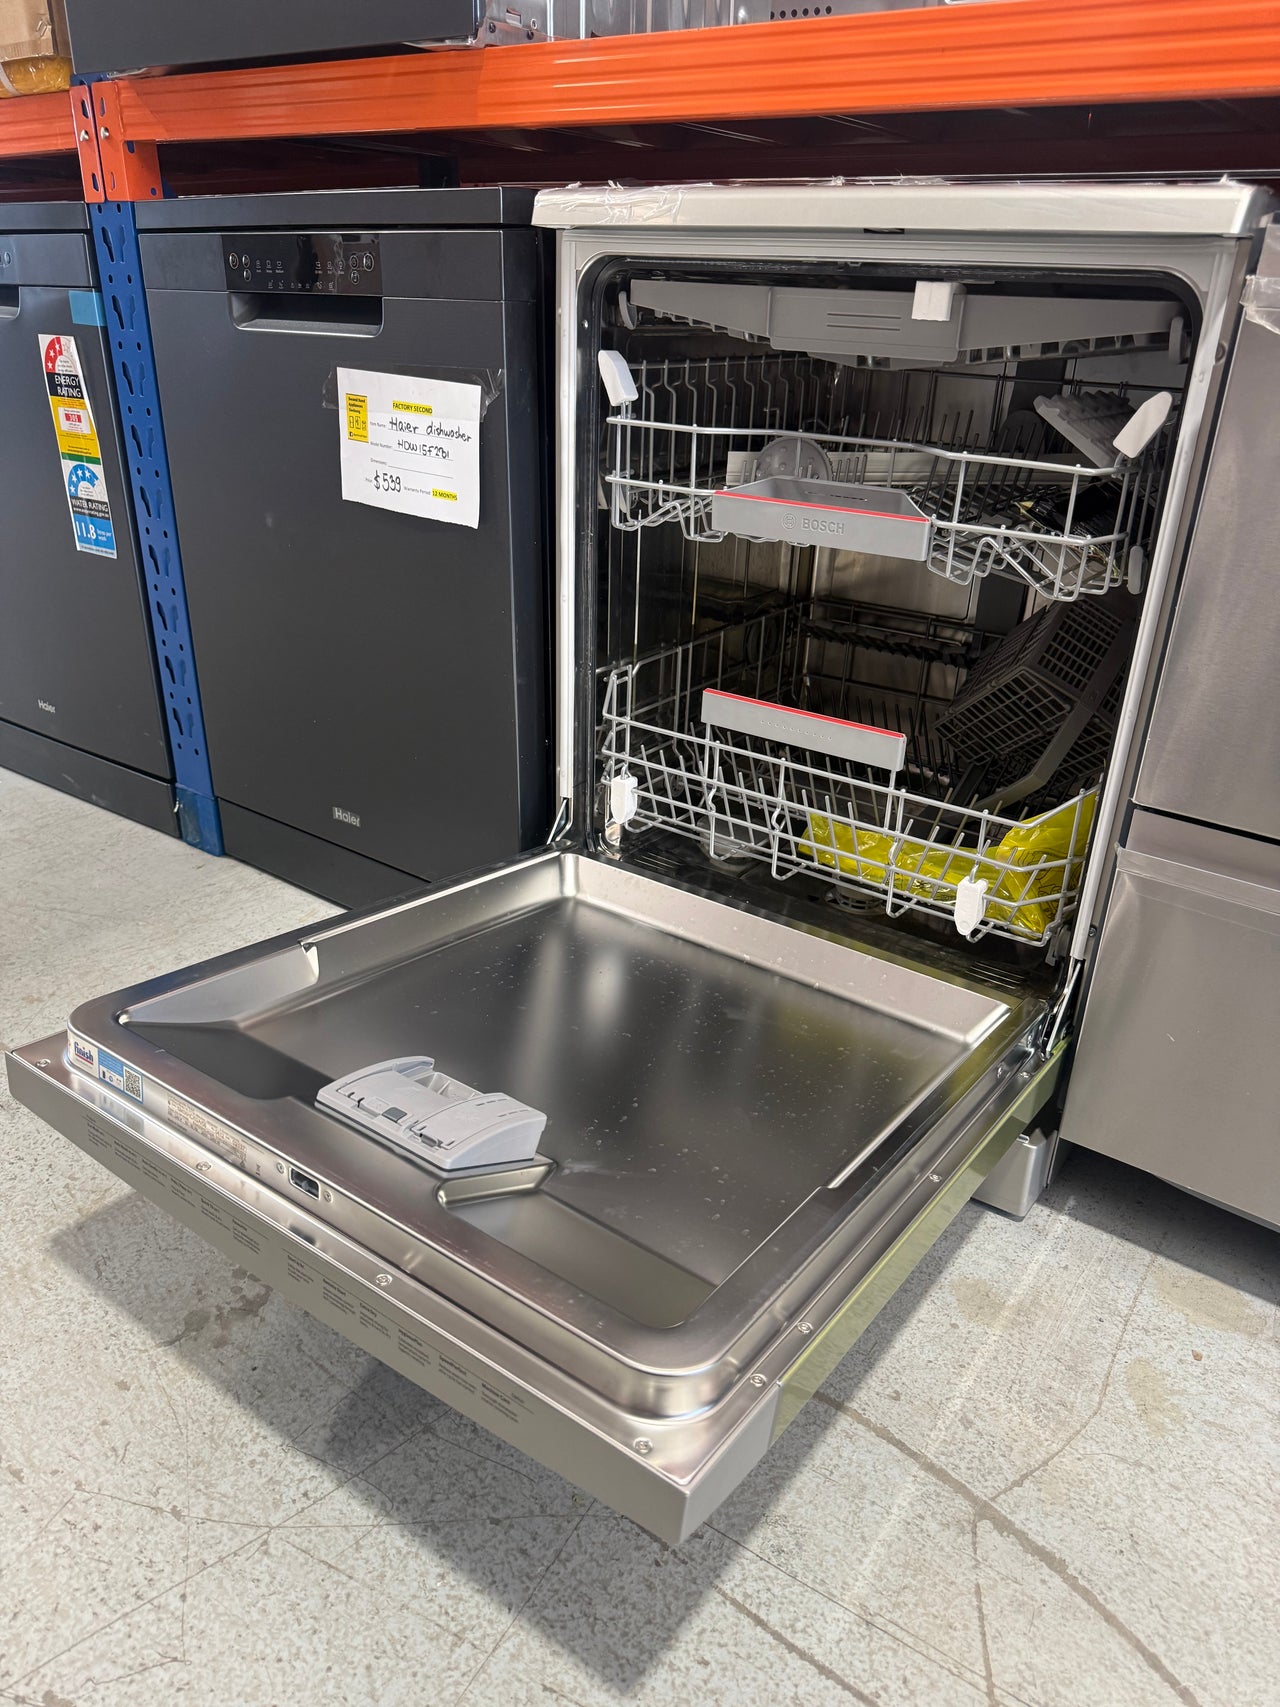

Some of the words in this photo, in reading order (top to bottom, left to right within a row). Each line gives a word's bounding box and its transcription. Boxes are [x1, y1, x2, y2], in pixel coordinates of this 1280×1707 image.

[54, 375, 79, 386] ENERGY
[57, 386, 82, 397] RATING
[392, 402, 413, 412] FACTORY
[413, 405, 433, 415] SECOND
[389, 416, 419, 434] Haier
[426, 420, 472, 443] dishwasher
[373, 469, 402, 493] $539
[438, 491, 458, 501] MONTHS
[70, 498, 88, 509] WATER
[88, 501, 109, 512] RATING
[75, 520, 97, 540] 11.8
[802, 517, 845, 535] BOSCH
[333, 806, 360, 827] Haier
[74, 1041, 94, 1062] finish
